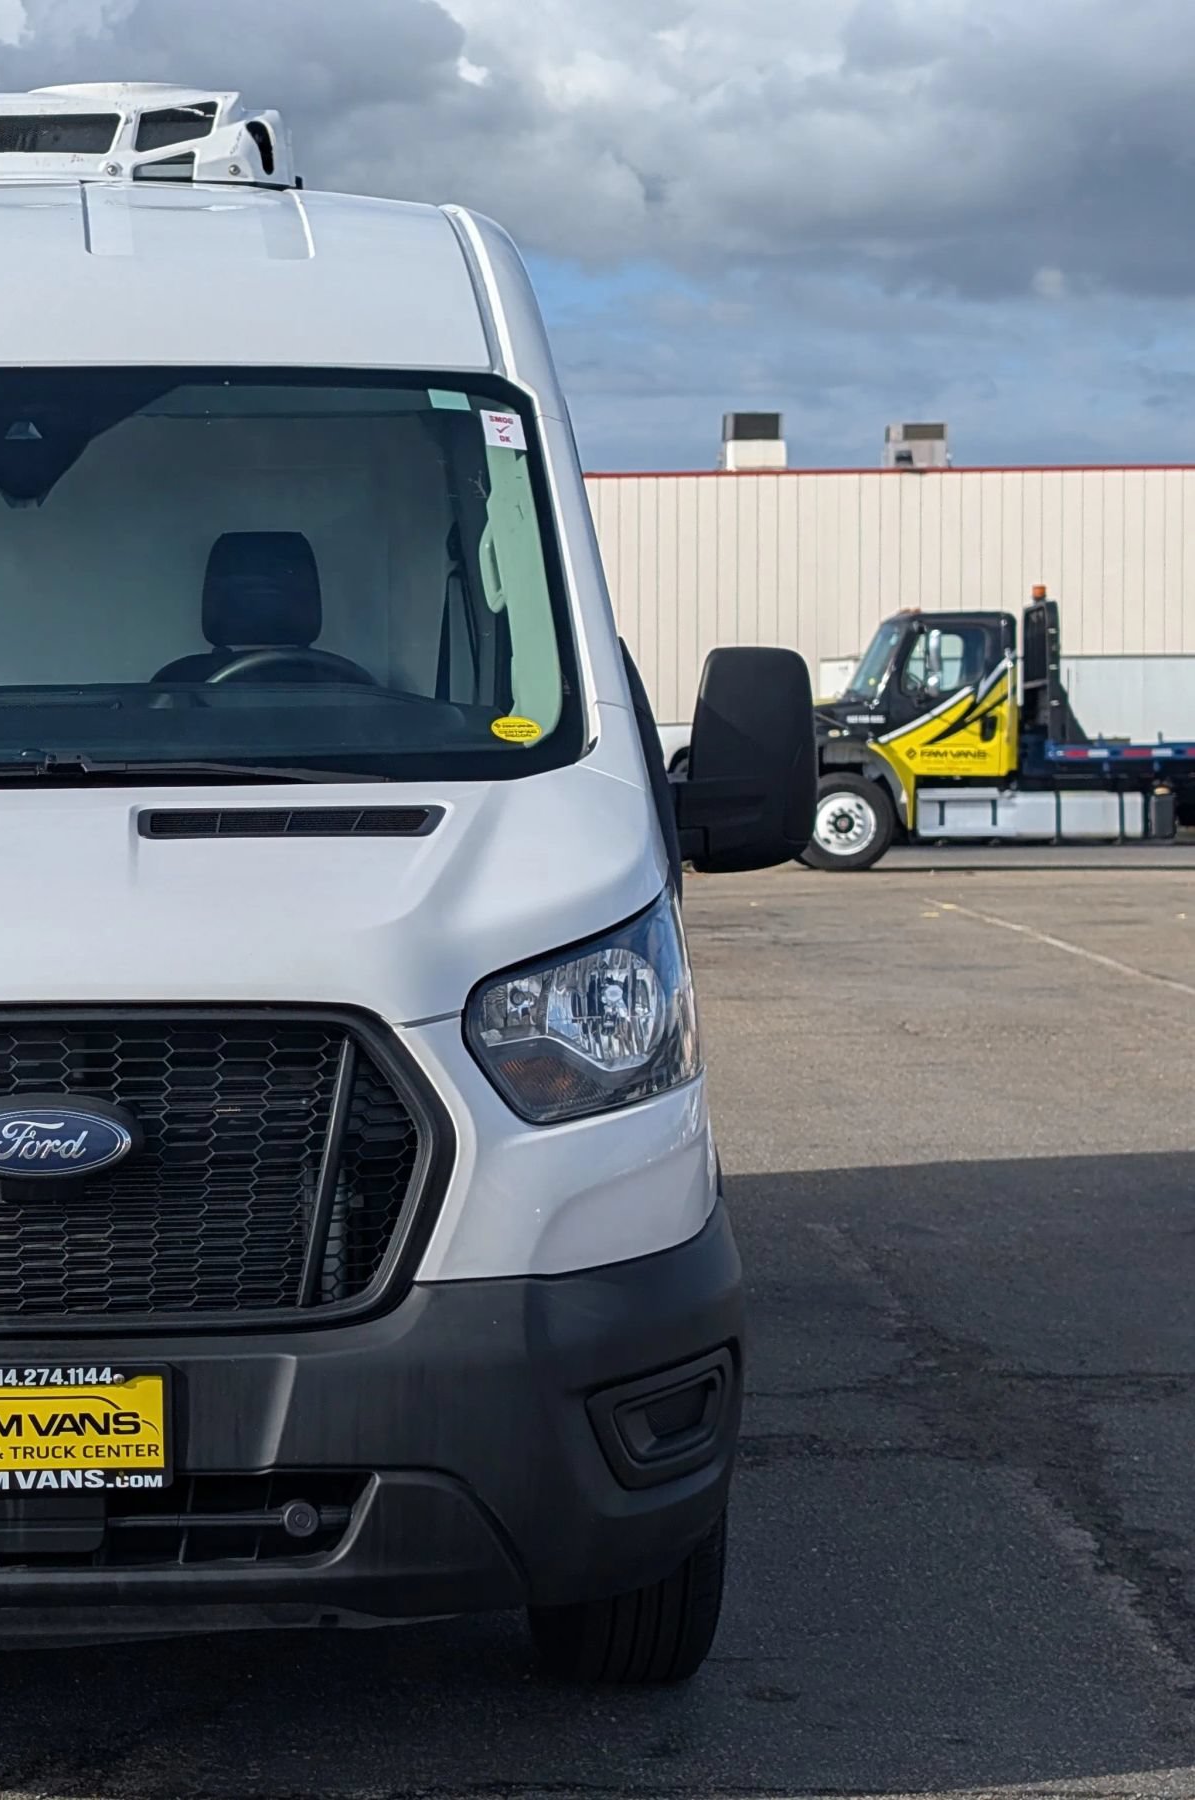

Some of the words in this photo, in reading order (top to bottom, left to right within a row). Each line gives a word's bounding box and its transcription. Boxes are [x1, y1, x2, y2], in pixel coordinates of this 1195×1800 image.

[489, 415, 514, 425] SMOG
[499, 435, 512, 443] OK
[920, 749, 948, 758] FAM
[950, 749, 988, 759] VANS
[27, 1411, 141, 1437] VANS
[9, 1444, 77, 1460] TRUCK
[82, 1443, 160, 1459] CENTER
